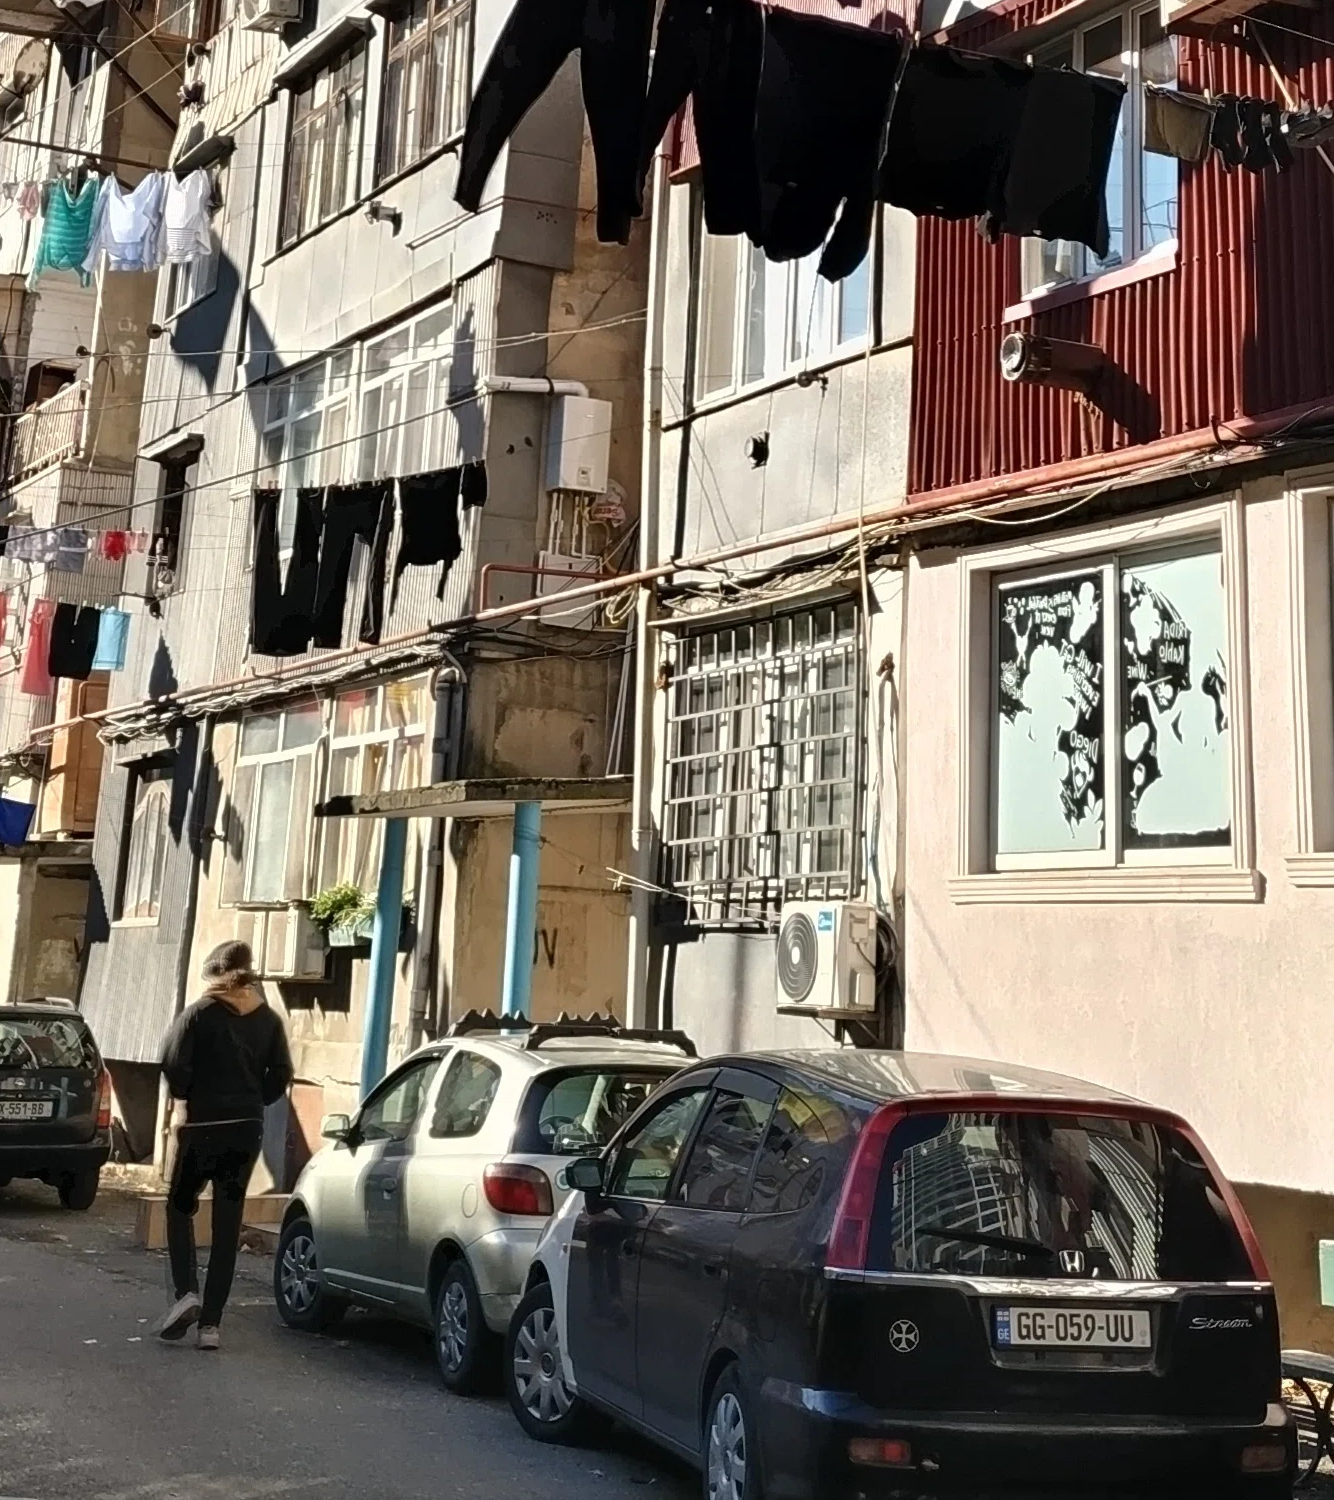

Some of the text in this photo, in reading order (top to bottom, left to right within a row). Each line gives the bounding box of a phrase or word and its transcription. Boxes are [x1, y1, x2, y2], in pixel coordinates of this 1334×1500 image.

[997, 1311, 1134, 1342] GE GG-059-UU
[1188, 1317, 1253, 1330] Stream
